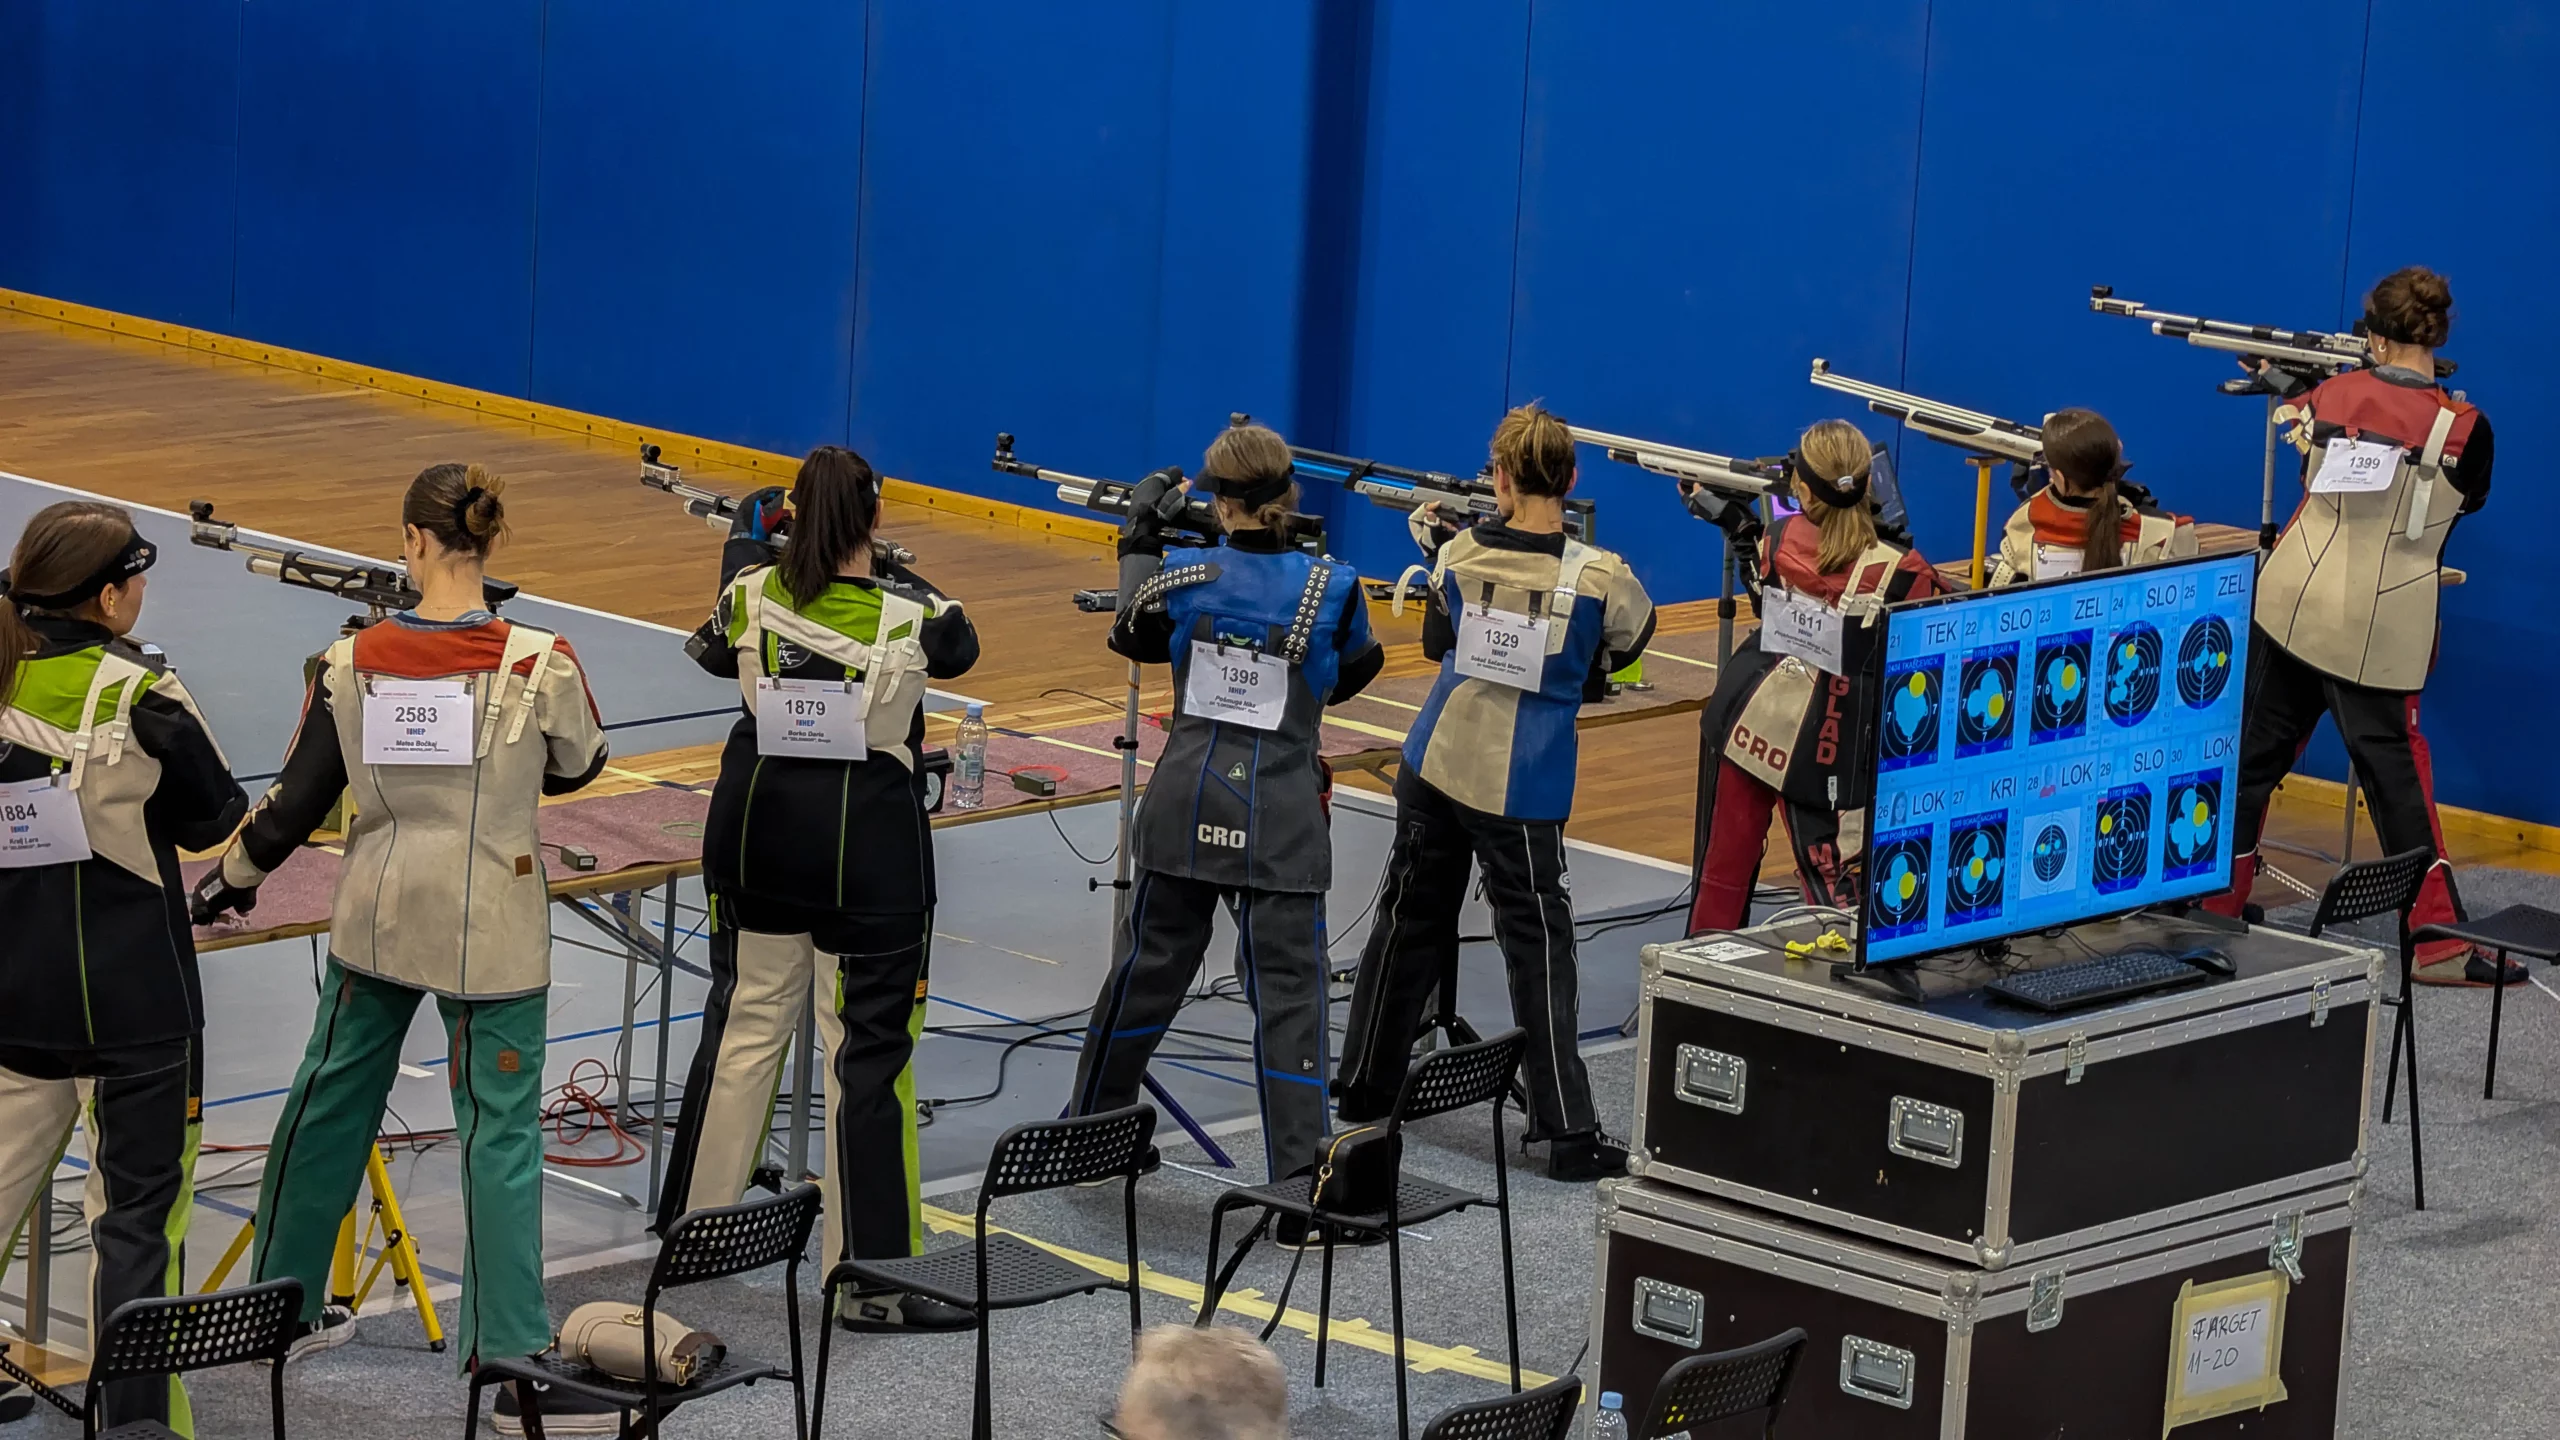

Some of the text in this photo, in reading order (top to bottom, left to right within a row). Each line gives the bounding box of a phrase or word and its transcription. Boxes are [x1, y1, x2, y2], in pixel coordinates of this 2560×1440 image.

[2350, 456, 2380, 469] 1399
[2112, 584, 2177, 611] 24 SLO
[2184, 574, 2246, 600] 25 ZEL
[1792, 610, 1822, 631] 1611
[1965, 608, 2032, 636] 22 SLO
[2040, 597, 2104, 623] 23 ZEL
[1485, 629, 1519, 648] 1329
[1890, 620, 1958, 648] 21 TEK
[1221, 666, 1258, 686] 1398
[395, 707, 438, 723] 2583
[785, 699, 826, 716] 1879
[1816, 676, 1849, 764] GLAD
[1733, 724, 1788, 772] CRO
[2172, 735, 2235, 763] 30 LOK
[2028, 762, 2093, 790] 28 LOK
[2100, 749, 2164, 777] 29 SLO
[1953, 776, 2017, 804] 27 KRI
[0, 803, 37, 821] 1884
[1878, 790, 1946, 819] 26 LOK
[1198, 824, 1246, 848] CRO
[2188, 1347, 2239, 1374] 11-20
